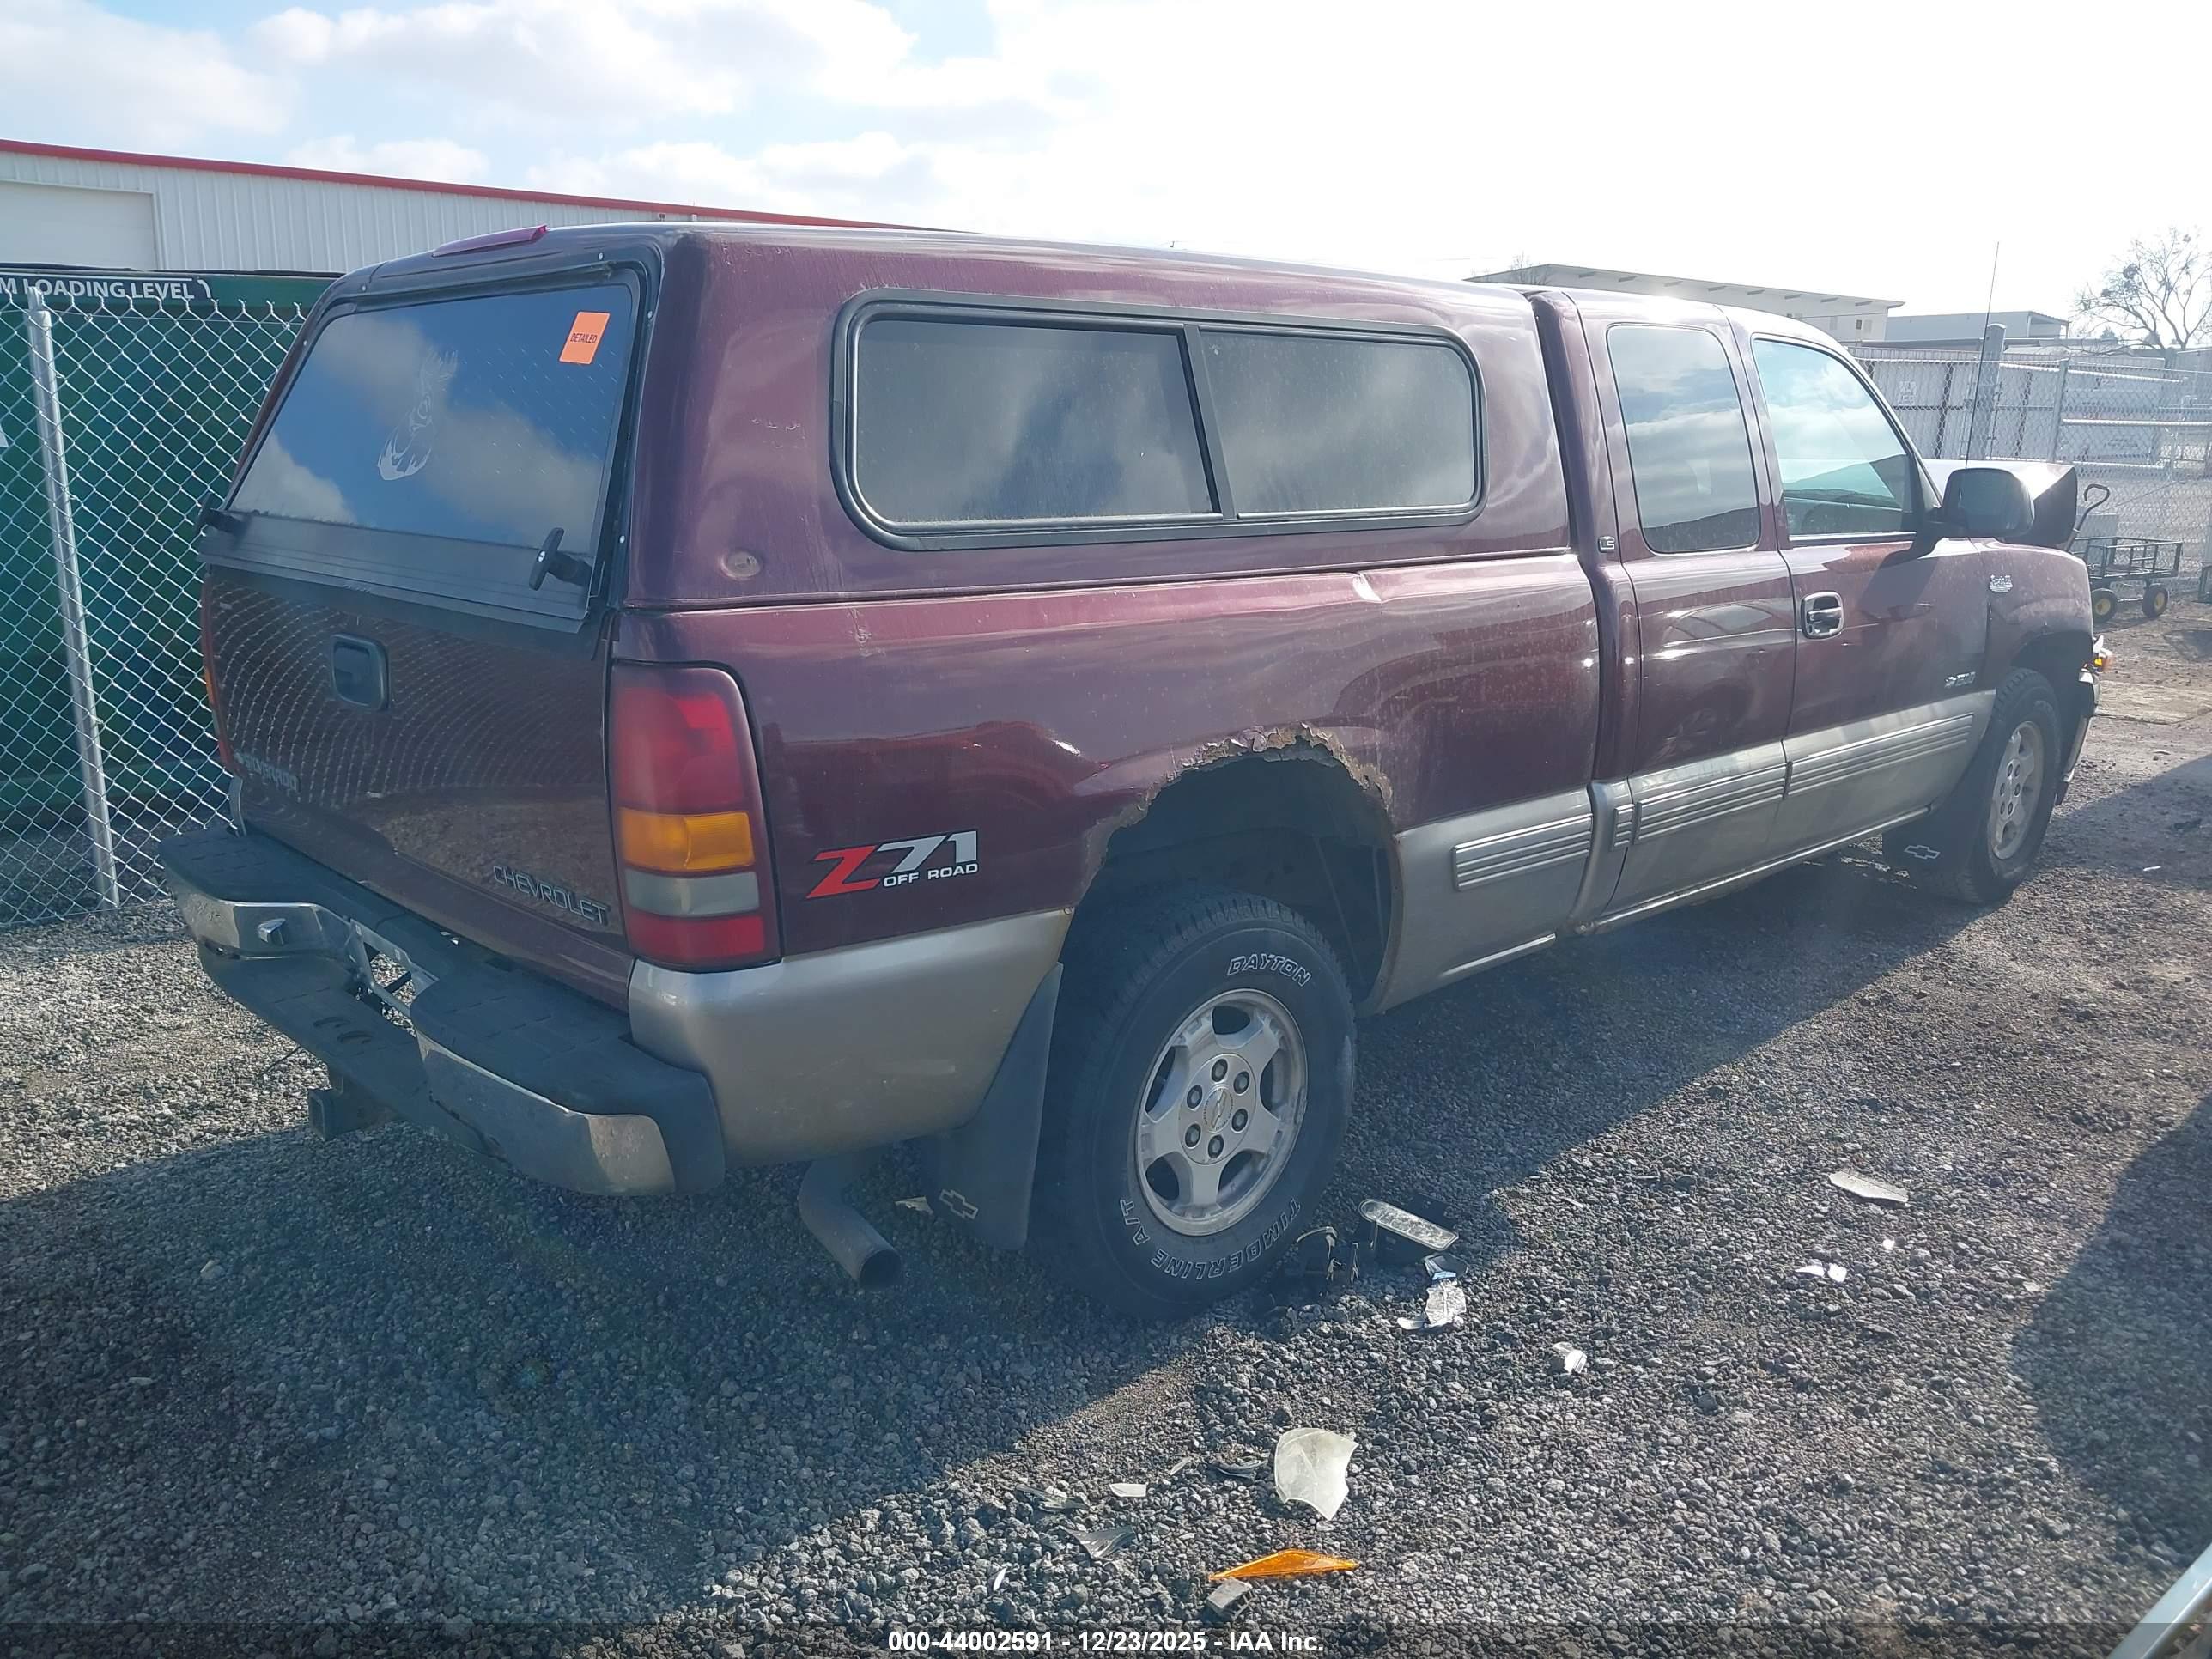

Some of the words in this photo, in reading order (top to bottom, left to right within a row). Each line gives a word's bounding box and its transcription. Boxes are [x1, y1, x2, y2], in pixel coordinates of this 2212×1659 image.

[131, 282, 195, 300] LEVEL
[569, 332, 598, 344] DETAILED
[805, 830, 978, 900] Z71
[883, 872, 920, 887] OFF
[927, 863, 979, 880] ROAD
[493, 865, 606, 925] CHEVROLET
[1226, 953, 1312, 987] DAYTON
[1120, 1199, 1151, 1245] A/T
[1150, 1198, 1301, 1279] TIMBERLINE
